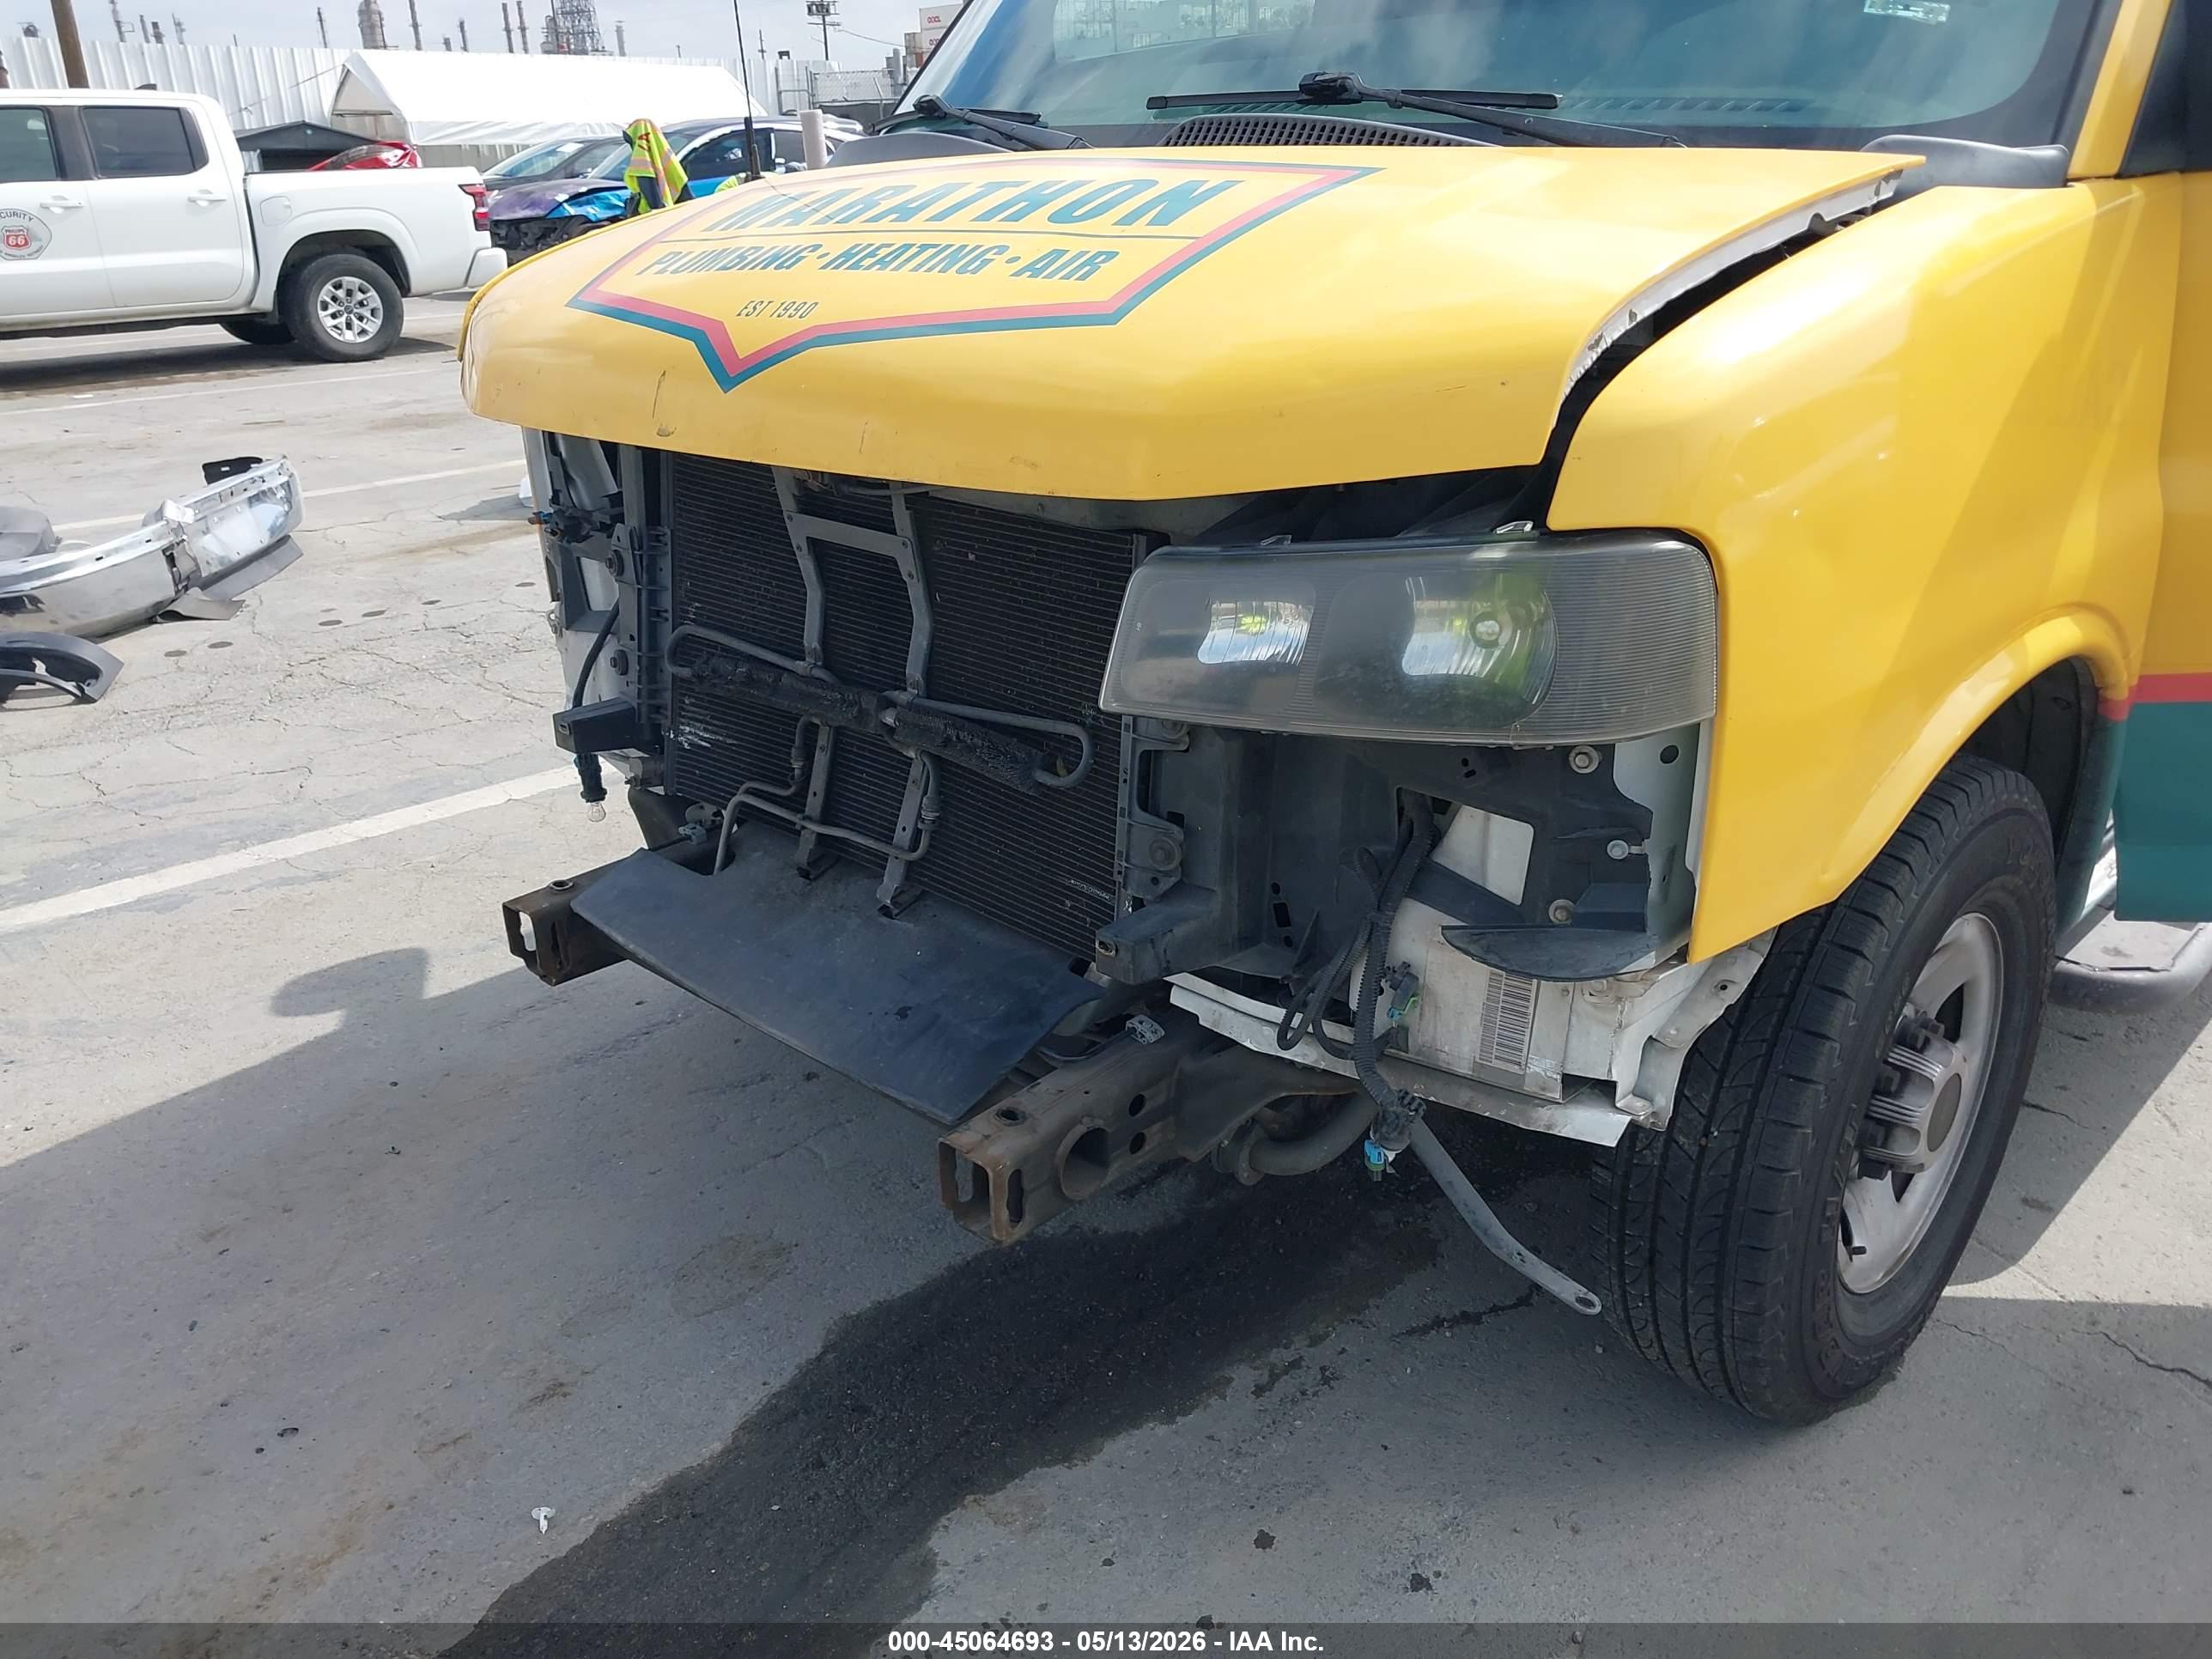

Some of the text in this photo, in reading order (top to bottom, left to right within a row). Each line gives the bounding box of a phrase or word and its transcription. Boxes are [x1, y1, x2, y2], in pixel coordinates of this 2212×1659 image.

[701, 179, 1246, 233] MARATHON
[9, 235, 26, 246] 66
[635, 243, 1121, 282] PLUMBING HEATING AIR
[735, 301, 819, 319] EST 1990
